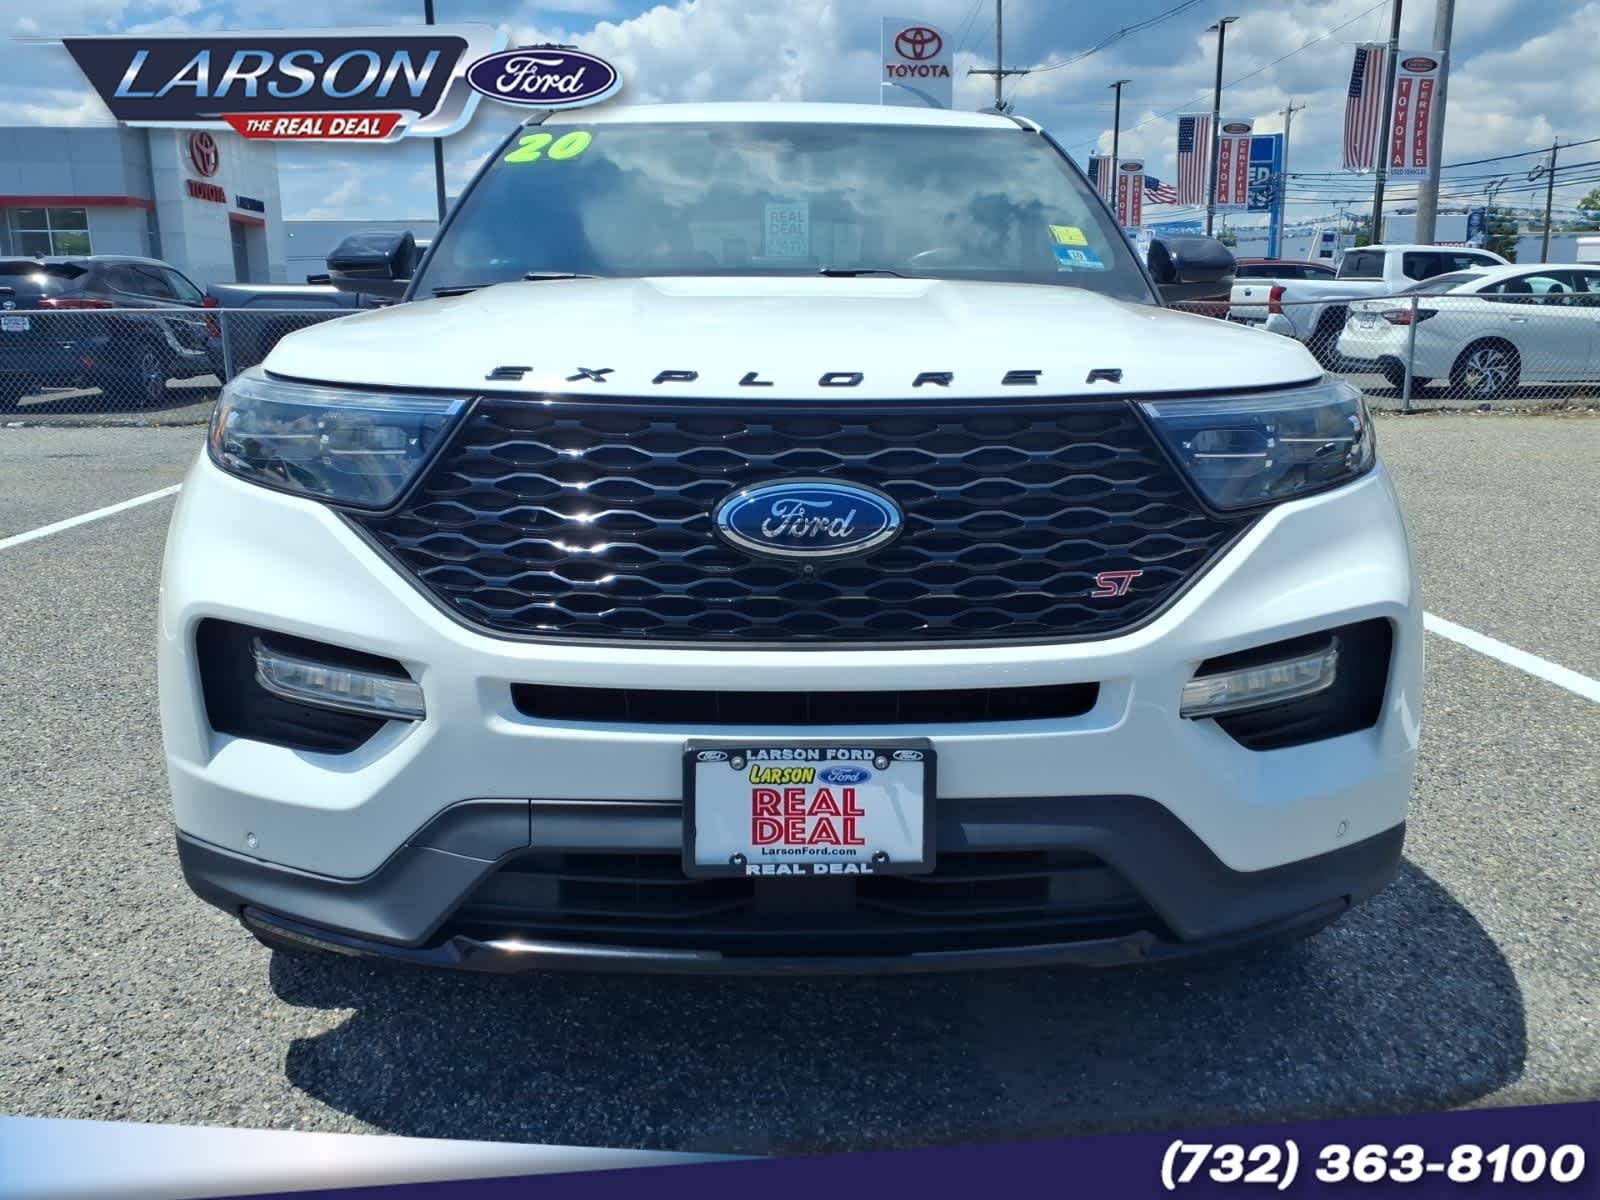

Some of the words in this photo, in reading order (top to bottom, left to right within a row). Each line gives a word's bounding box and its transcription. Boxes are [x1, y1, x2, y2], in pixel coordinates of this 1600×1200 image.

[886, 65, 950, 78] TOYOTA
[1393, 81, 1409, 165] TOYOTA
[1415, 81, 1430, 165] CERTIFIED
[504, 131, 592, 163] 20
[186, 180, 226, 203] TOYOTA
[485, 366, 1122, 387] EXPLORER
[762, 499, 855, 539] Ford
[1091, 570, 1143, 598] ST
[747, 749, 820, 761] LARSON
[827, 749, 875, 760] FORD
[827, 768, 860, 783] Ford
[752, 788, 865, 816] REAL
[752, 817, 865, 845] DEAL
[761, 846, 857, 856] LarsonFord.com
[745, 863, 805, 875] REAL
[813, 863, 874, 875] DEAL
